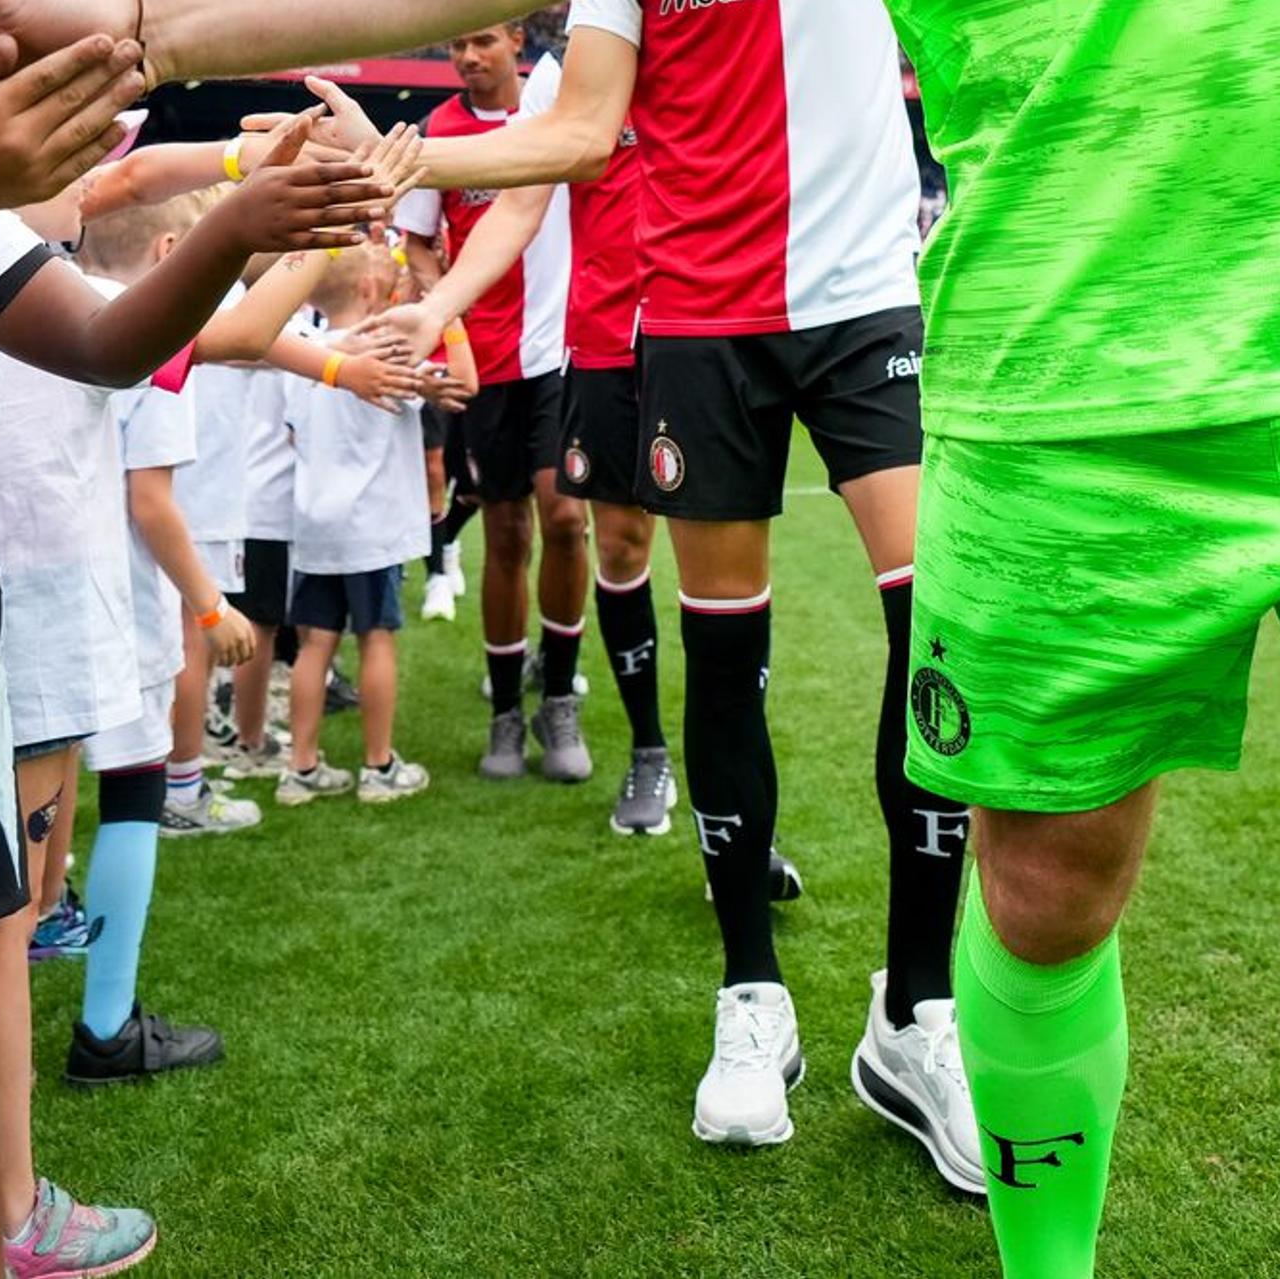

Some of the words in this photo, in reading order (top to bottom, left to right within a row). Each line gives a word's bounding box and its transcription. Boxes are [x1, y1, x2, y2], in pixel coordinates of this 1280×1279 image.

[886, 350, 921, 379] fai
[617, 638, 655, 676] F
[694, 811, 743, 856] F
[913, 809, 972, 858] F
[980, 1123, 1085, 1189] F
